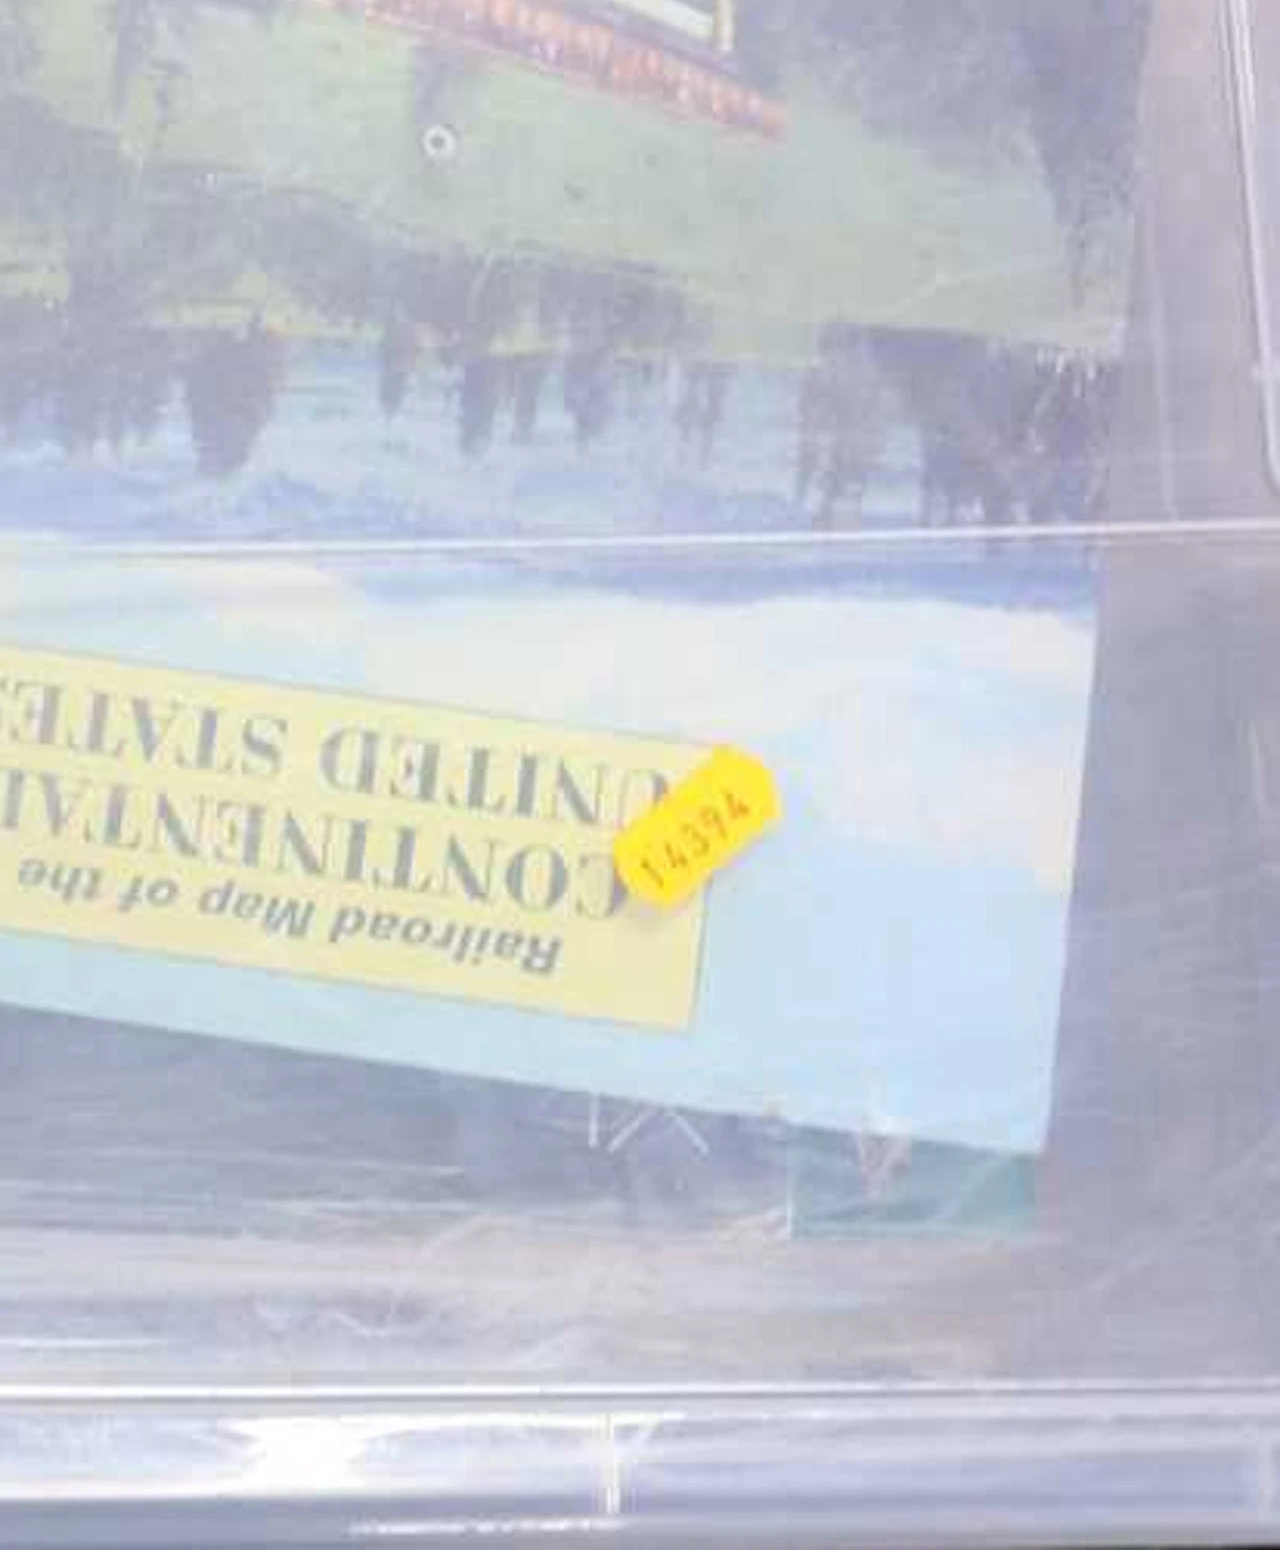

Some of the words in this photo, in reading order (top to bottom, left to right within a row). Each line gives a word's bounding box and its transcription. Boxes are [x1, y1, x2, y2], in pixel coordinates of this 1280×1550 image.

[318, 715, 672, 831] UNITED
[638, 788, 752, 891] 14394
[14, 854, 104, 901] the
[120, 866, 186, 915] of
[196, 880, 316, 947] Map
[326, 901, 565, 976] Railroad
